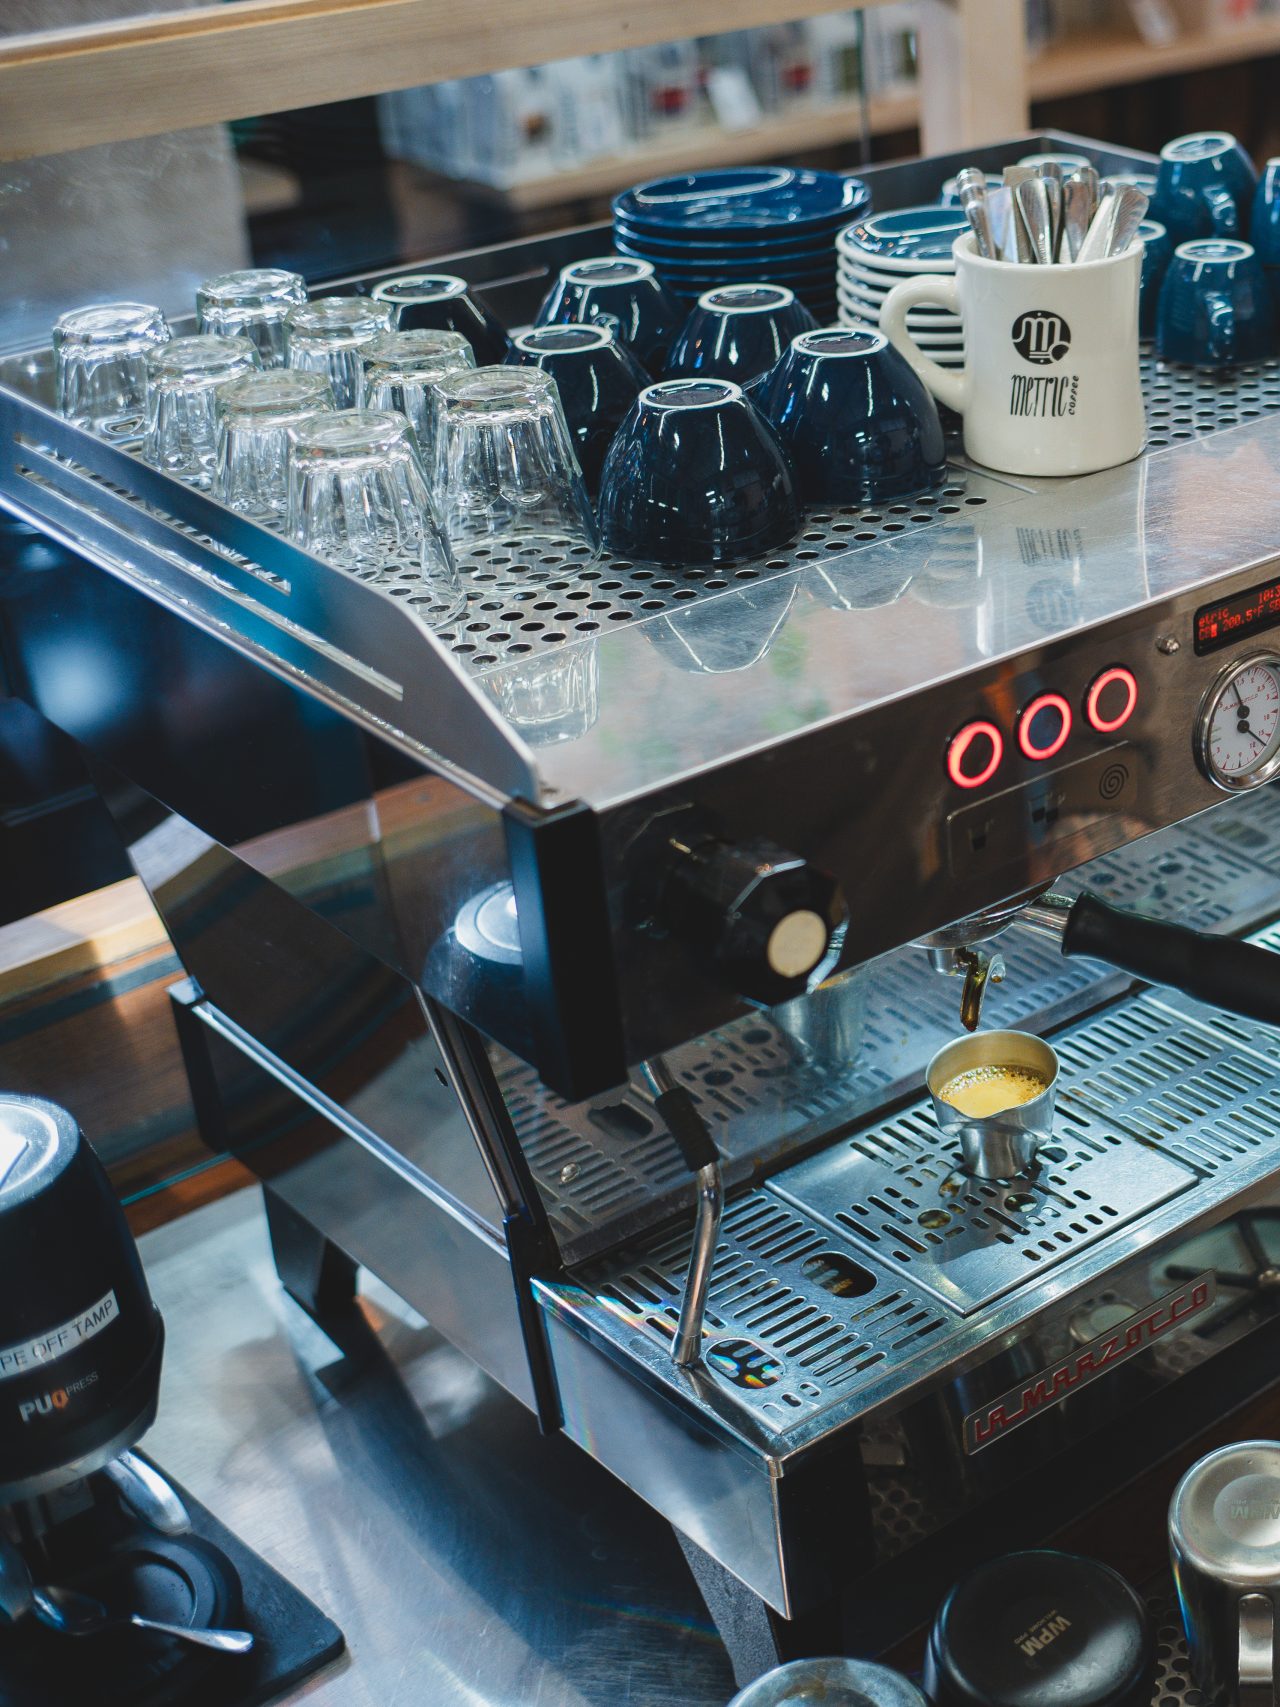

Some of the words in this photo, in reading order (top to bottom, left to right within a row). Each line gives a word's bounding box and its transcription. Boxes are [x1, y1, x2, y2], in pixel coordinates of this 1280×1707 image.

[32, 1330, 69, 1359] OFF
[72, 1299, 113, 1338] TAMP
[65, 1371, 99, 1397] PRESS
[1020, 1615, 1072, 1657] WPM
